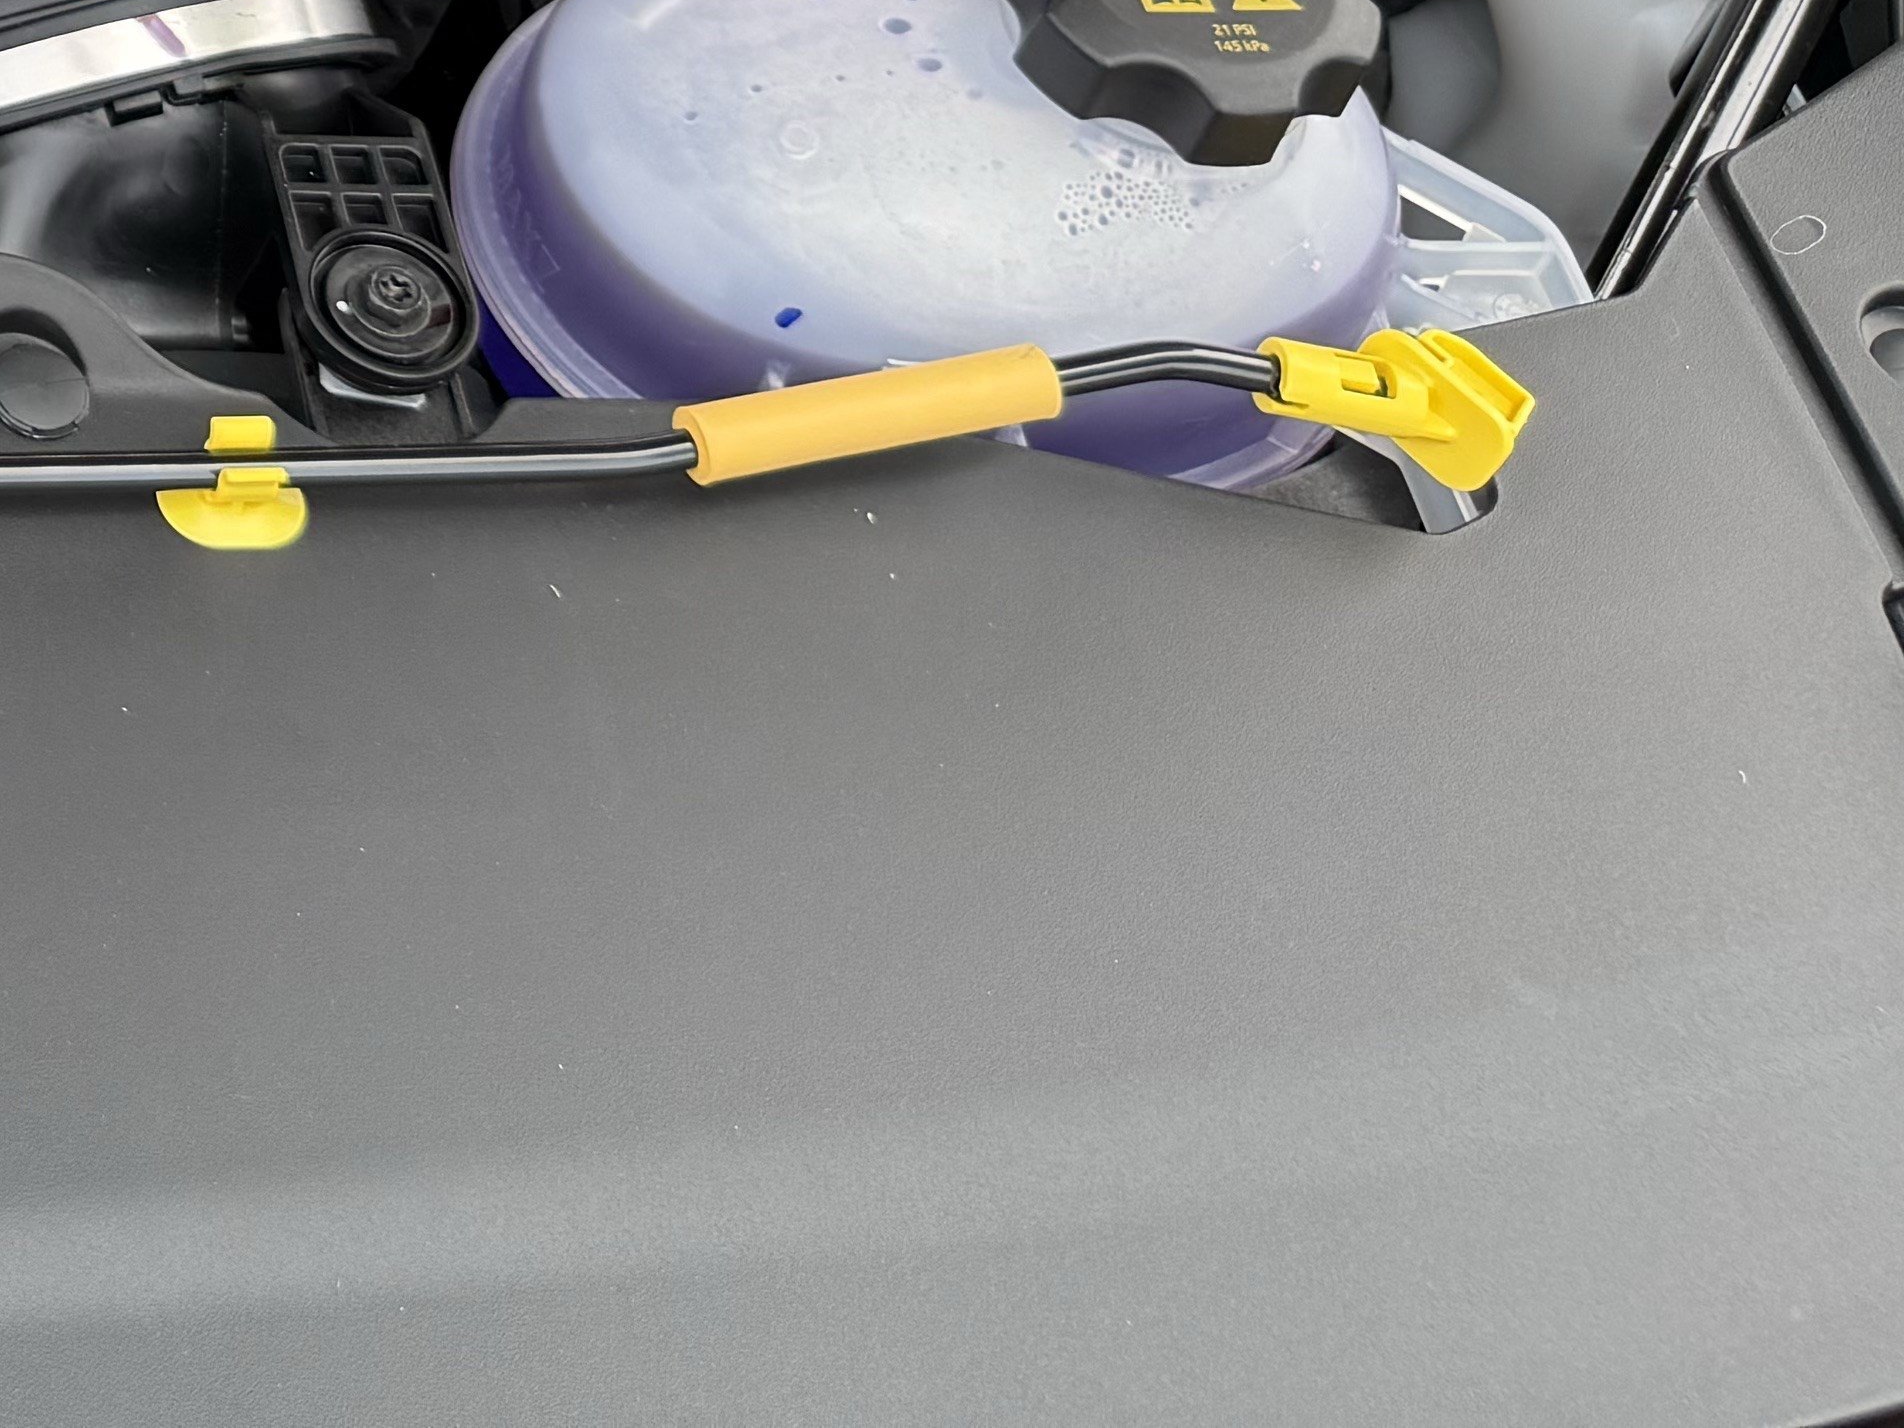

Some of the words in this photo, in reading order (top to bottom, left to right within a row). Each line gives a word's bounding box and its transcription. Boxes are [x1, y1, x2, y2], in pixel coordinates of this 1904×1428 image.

[1212, 23, 1232, 38] 21
[1233, 23, 1256, 37] PSI
[1214, 39, 1239, 54] 145
[1240, 39, 1270, 54] kPa
